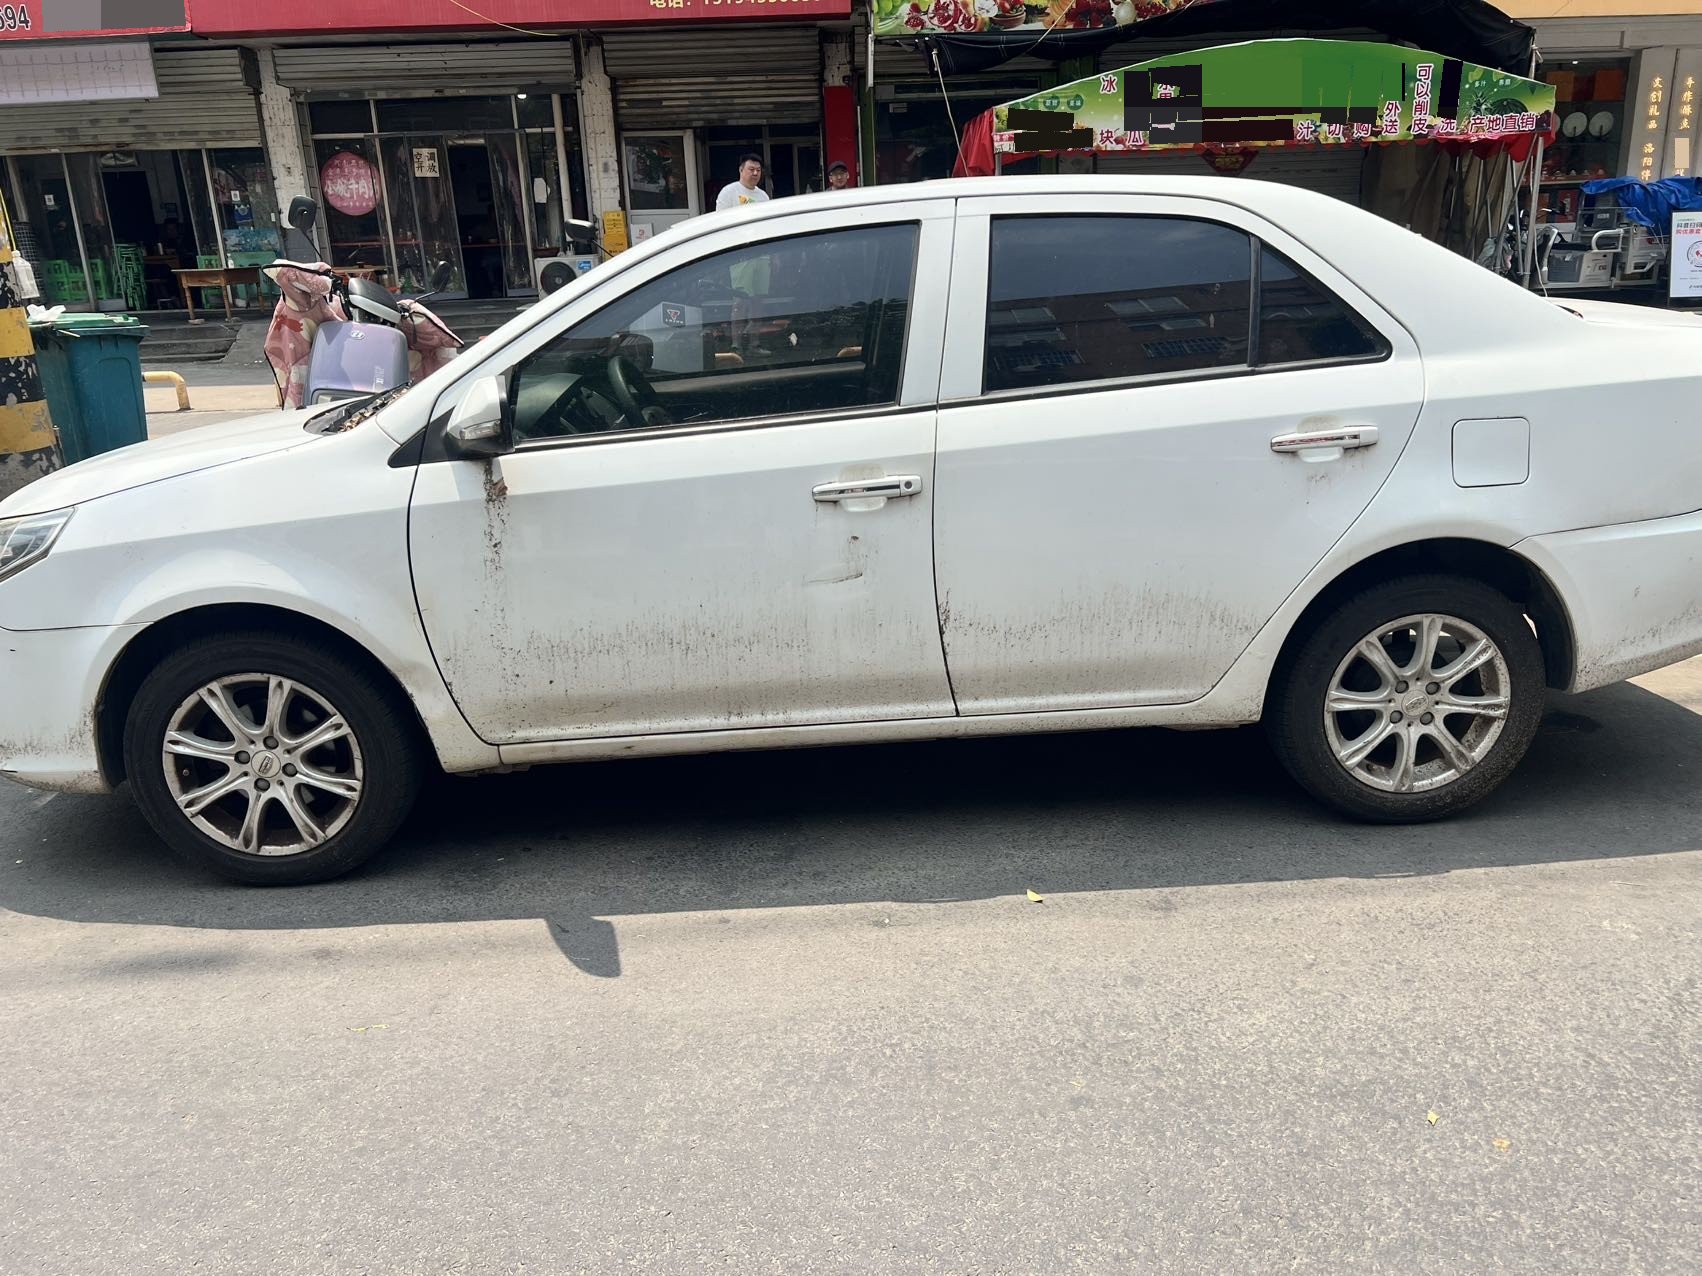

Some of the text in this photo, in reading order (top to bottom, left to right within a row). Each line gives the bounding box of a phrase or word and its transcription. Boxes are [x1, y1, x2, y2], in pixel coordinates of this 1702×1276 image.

[1101, 75, 1118, 94] 冰
[1411, 64, 1433, 135] 可以削皮
[1648, 77, 1663, 129] 文创礼品
[1383, 101, 1401, 136] 外送
[1470, 112, 1537, 133] 产地直销
[1099, 128, 1116, 146] 块
[1297, 121, 1315, 141] 汁
